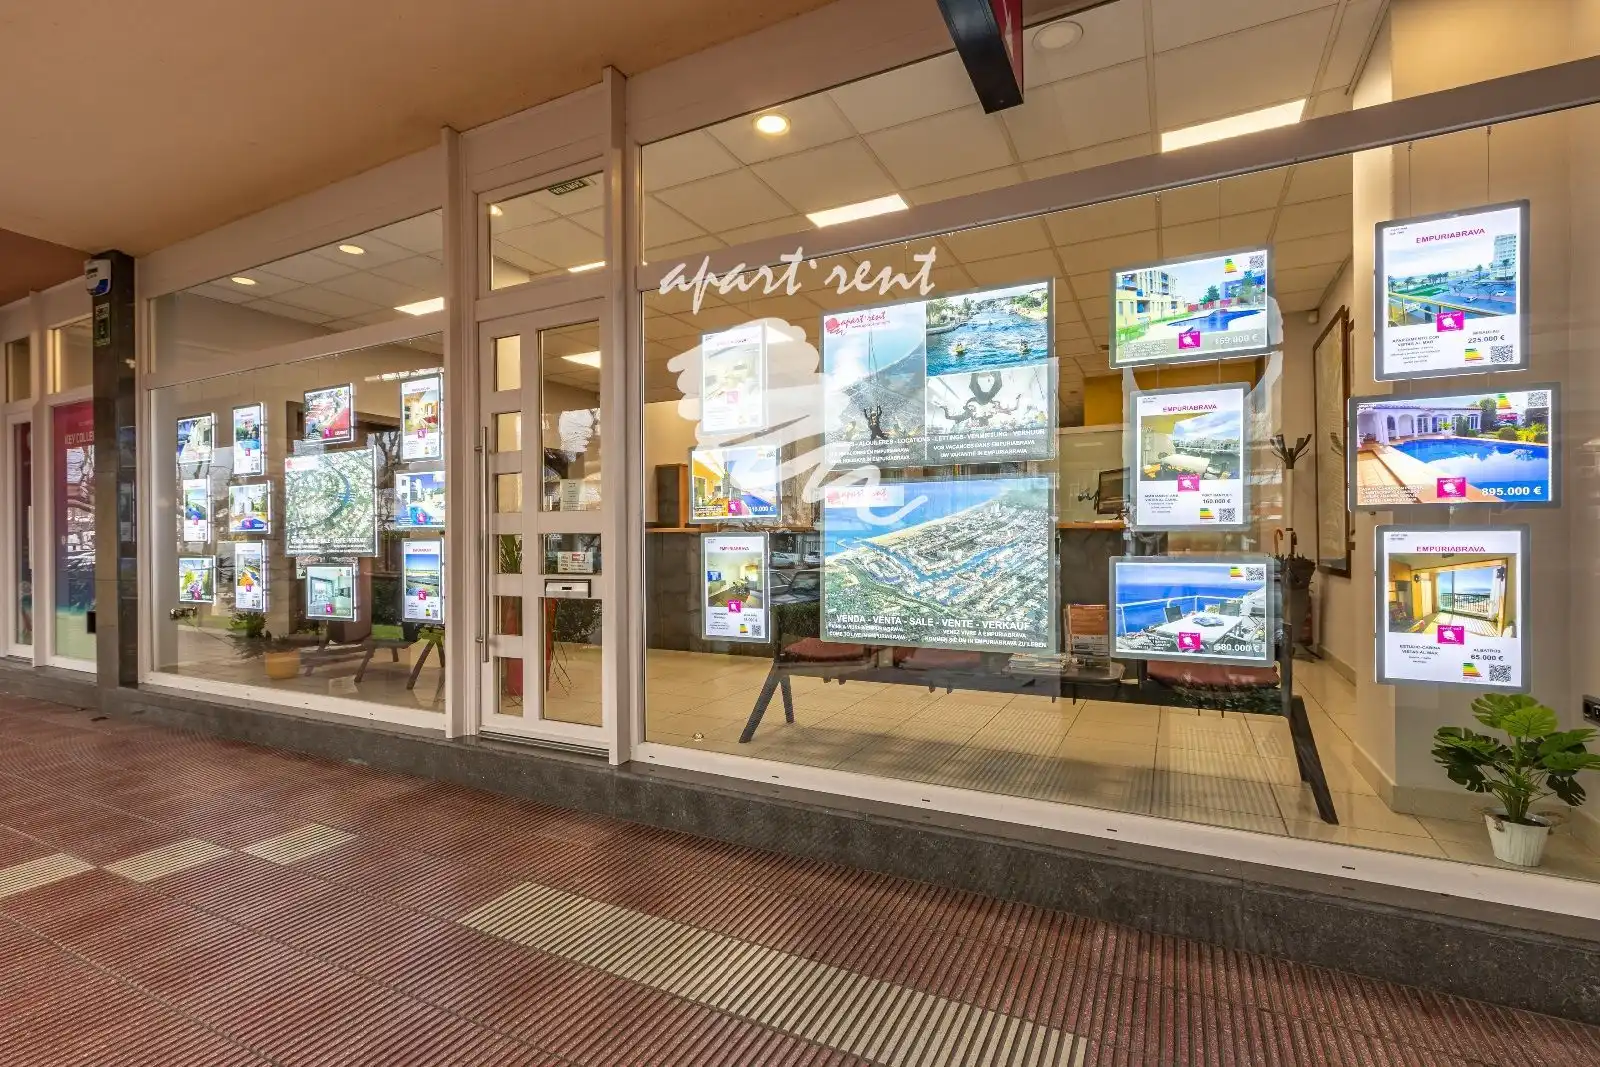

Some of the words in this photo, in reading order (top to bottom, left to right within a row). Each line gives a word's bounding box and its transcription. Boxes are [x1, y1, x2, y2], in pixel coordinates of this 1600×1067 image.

[1416, 228, 1485, 244] EMPURIABRAVA
[1467, 336, 1498, 344] 225.000
[1162, 404, 1217, 413] EMPURIABRAVA
[1481, 486, 1530, 496] 895.000
[1533, 486, 1542, 495] €
[836, 615, 866, 623] VENDA
[872, 615, 902, 625] VENTA
[909, 617, 934, 626] SALE
[941, 619, 974, 628] VENTE
[982, 620, 1031, 631] VERKAUF
